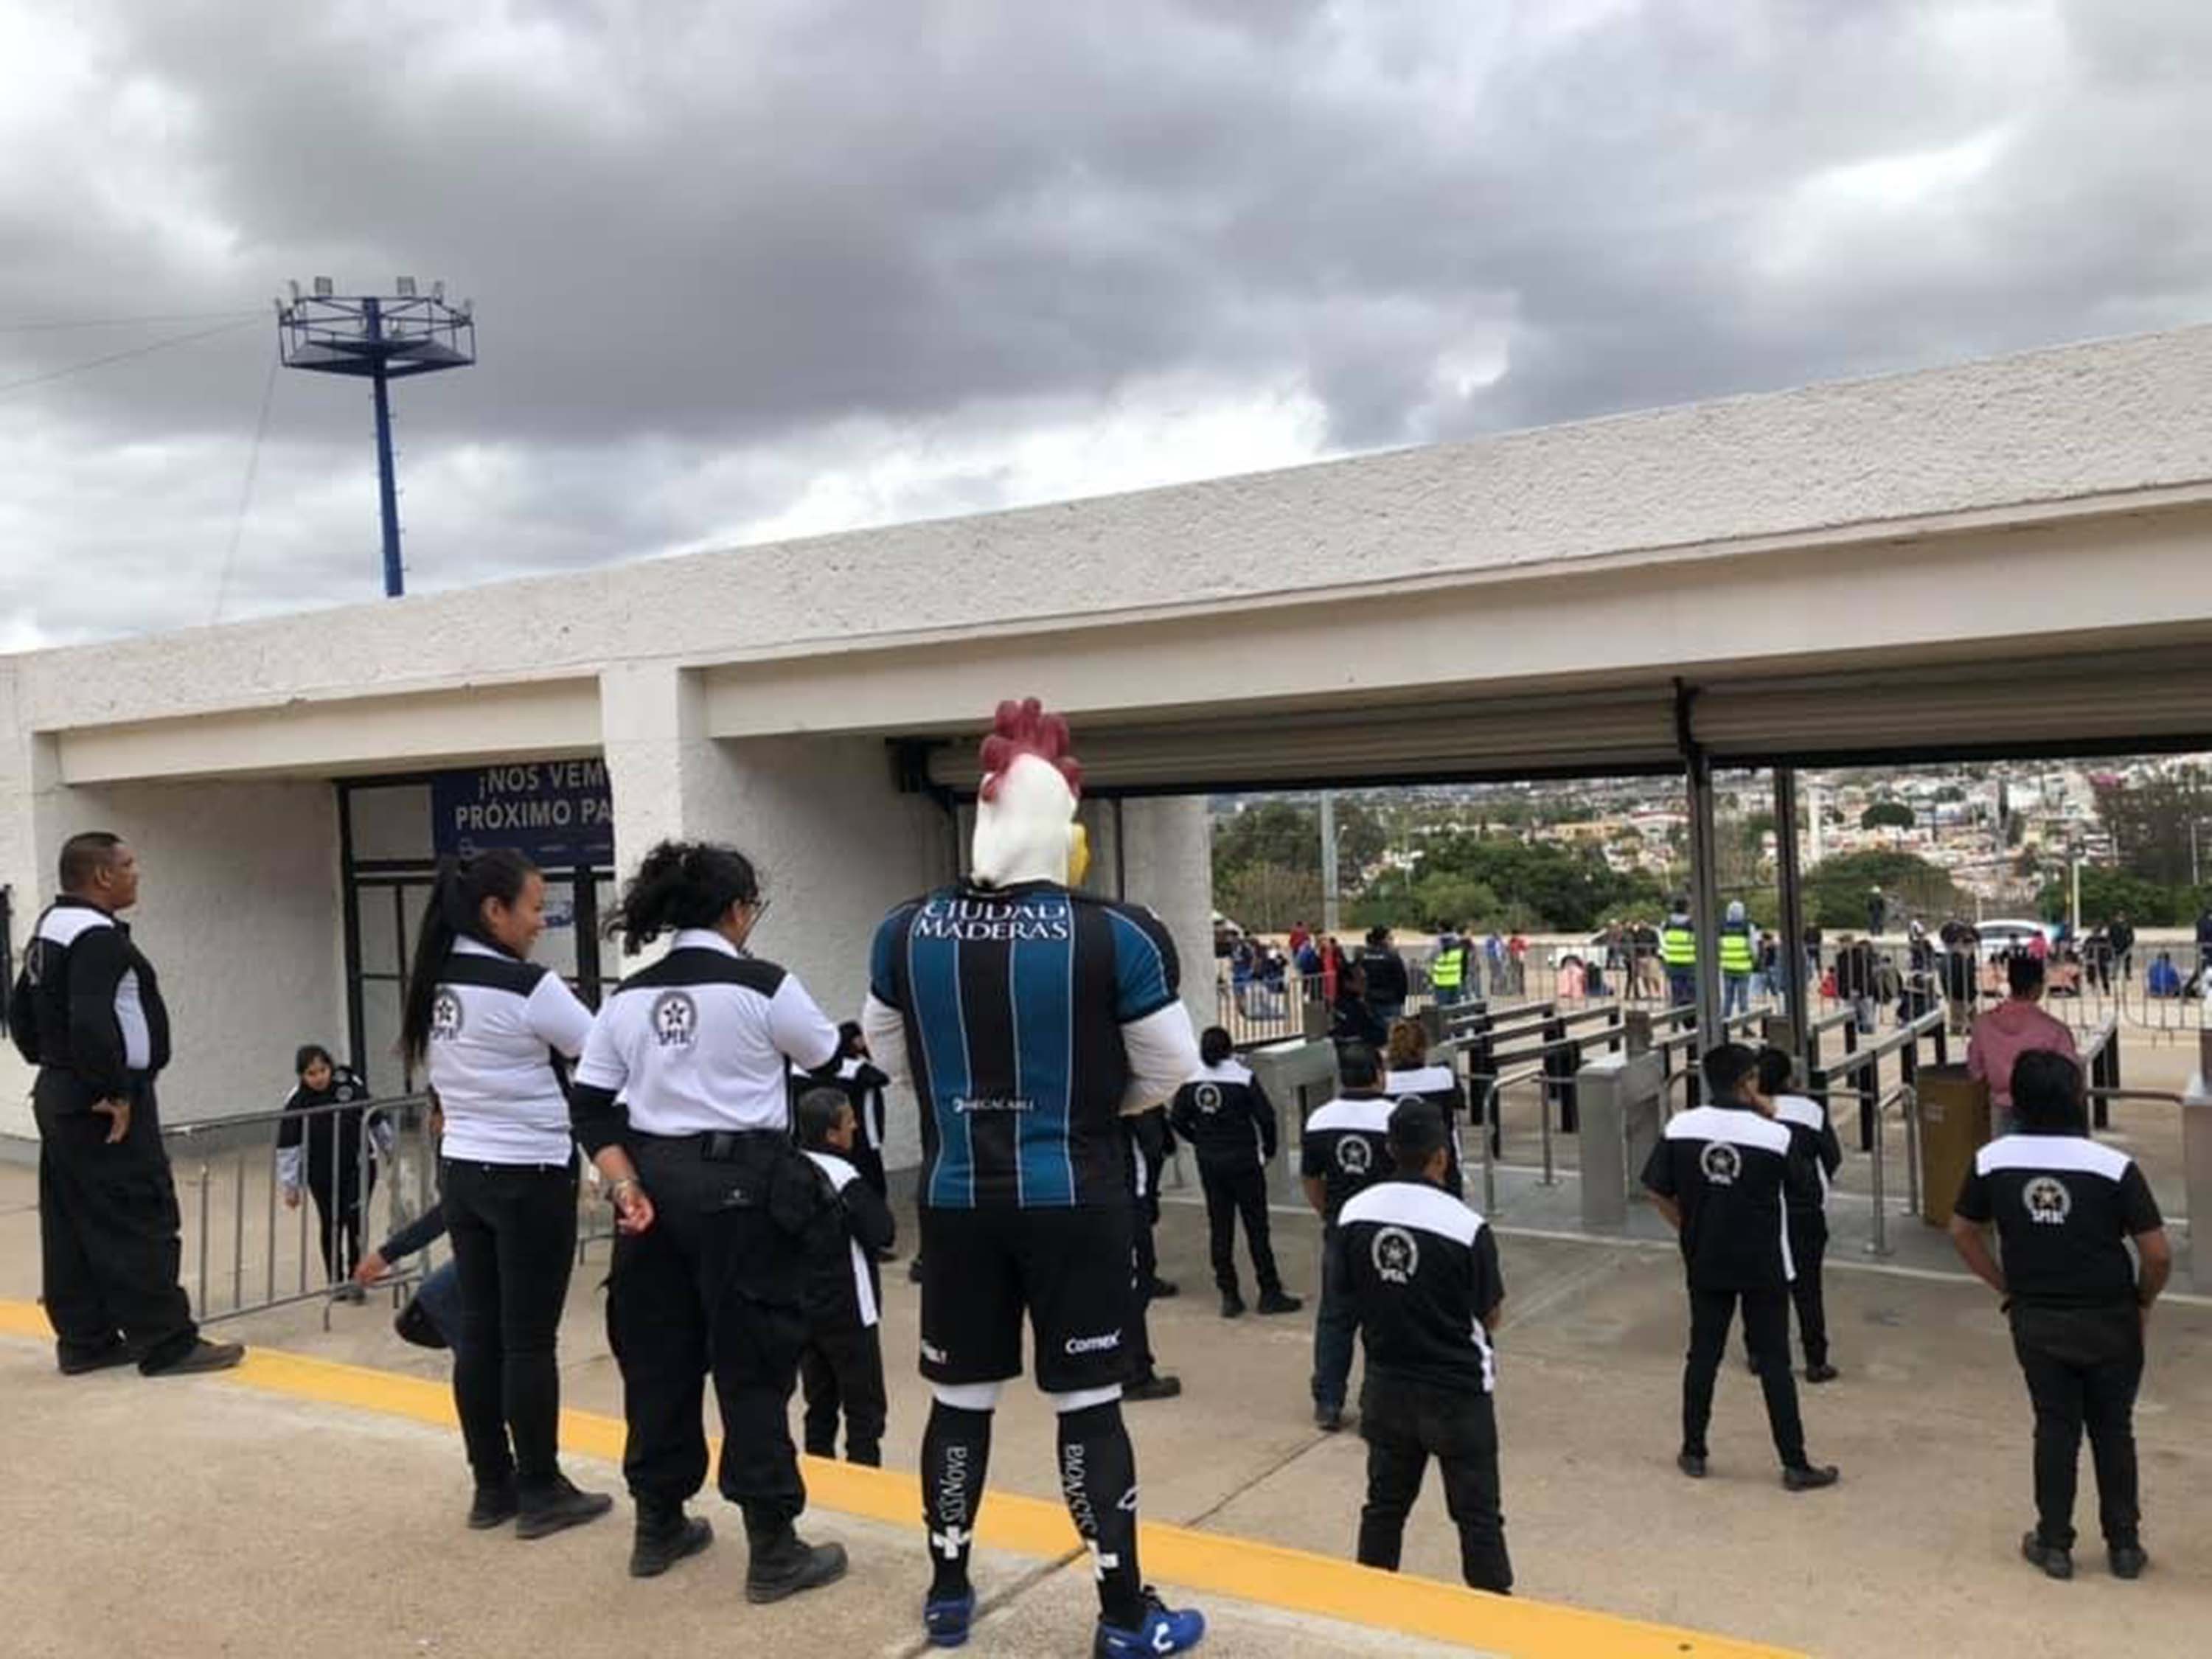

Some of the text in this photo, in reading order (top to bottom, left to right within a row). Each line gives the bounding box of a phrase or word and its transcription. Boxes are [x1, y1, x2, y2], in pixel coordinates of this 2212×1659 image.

[455, 797, 613, 831] PRÓXIMO PA
[923, 897, 1065, 920] CIUDAD
[914, 917, 1068, 940] MADERAS
[1065, 1328, 1121, 1354] Comex
